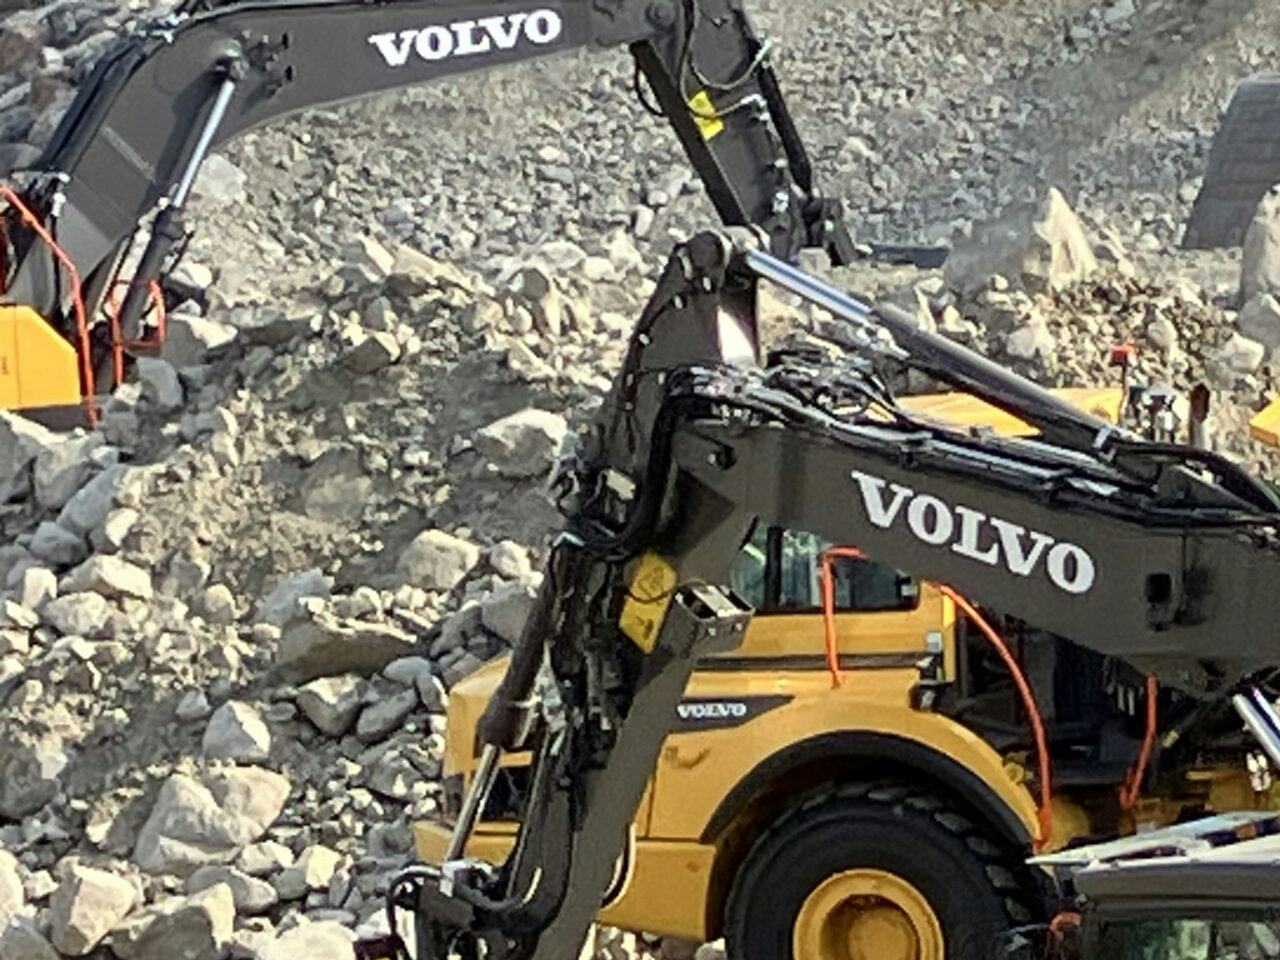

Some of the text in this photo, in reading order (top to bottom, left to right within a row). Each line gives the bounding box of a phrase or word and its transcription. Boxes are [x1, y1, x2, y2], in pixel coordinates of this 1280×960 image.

[368, 8, 562, 67] VOLVO
[851, 470, 1096, 593] VOLVO
[677, 702, 747, 718] VOLVO
